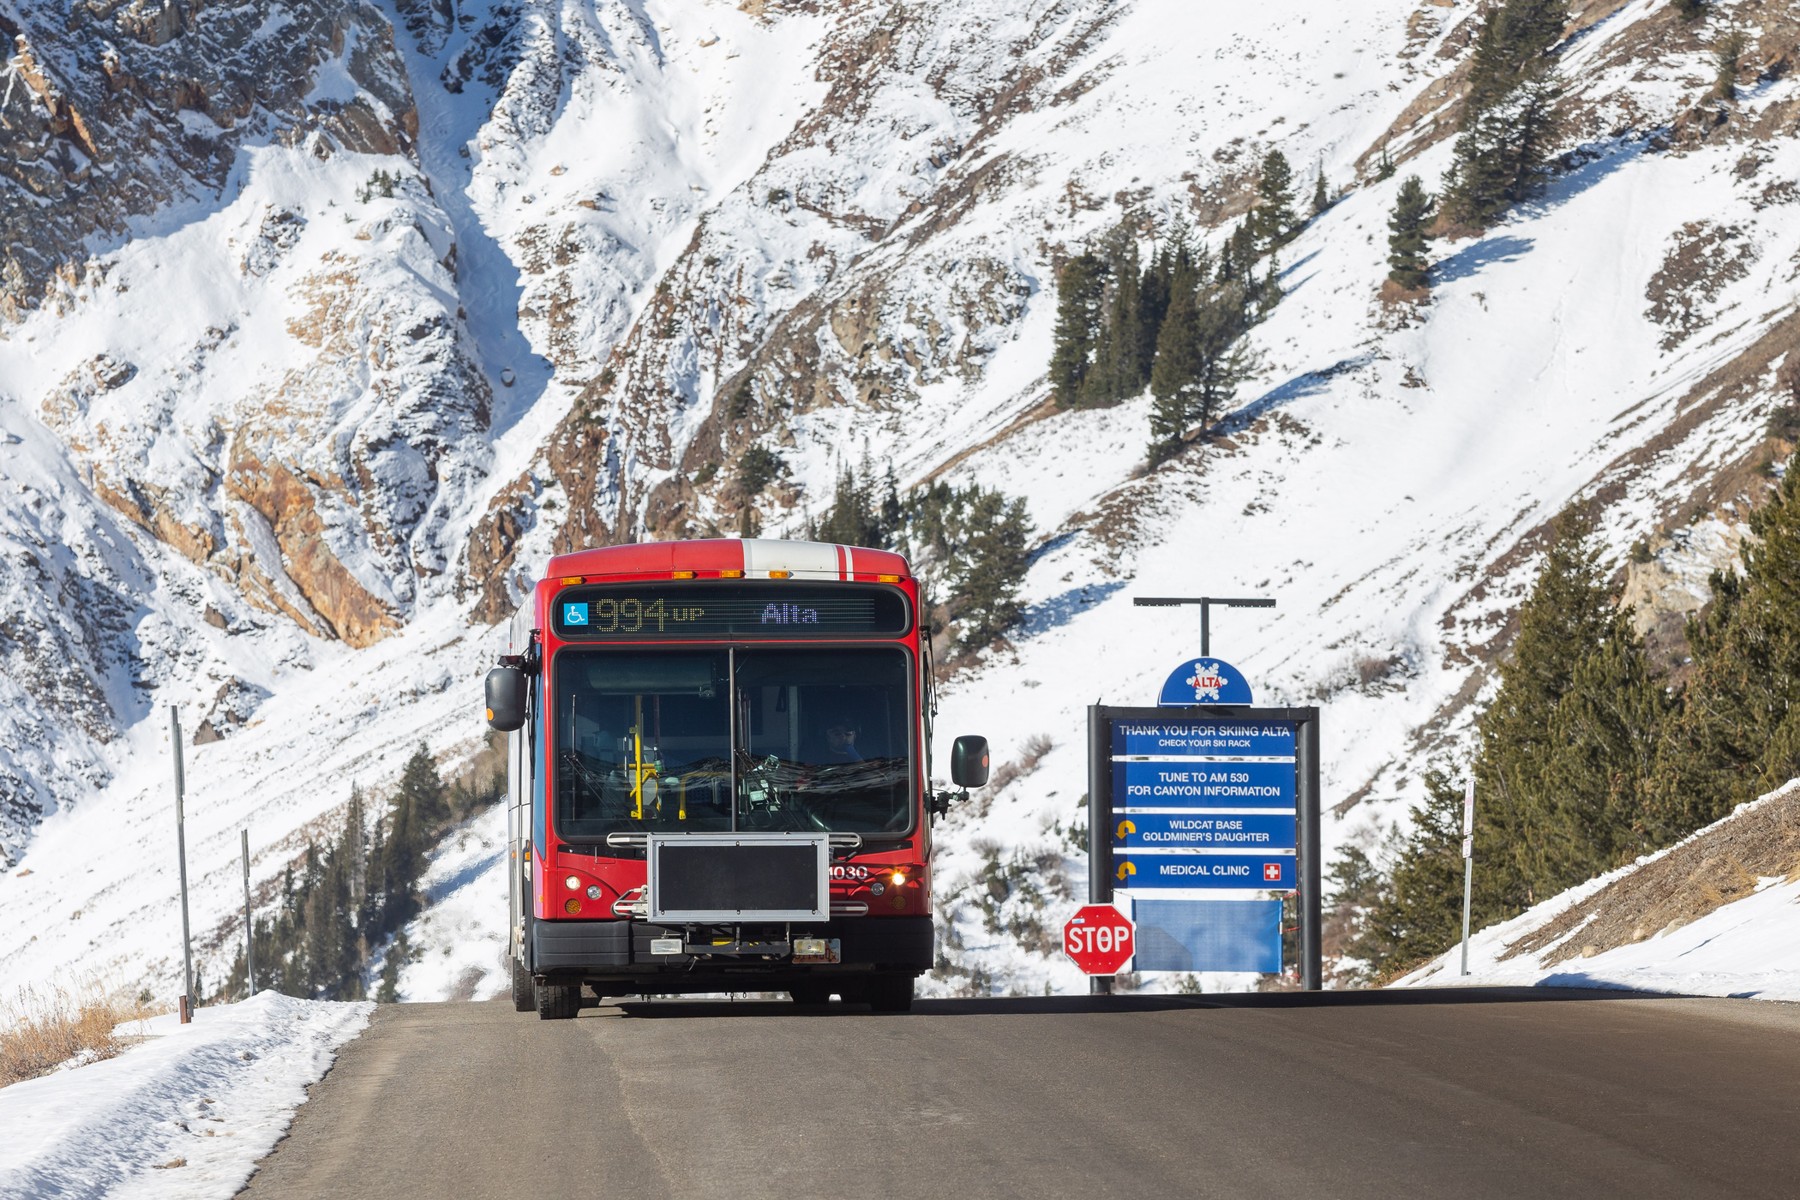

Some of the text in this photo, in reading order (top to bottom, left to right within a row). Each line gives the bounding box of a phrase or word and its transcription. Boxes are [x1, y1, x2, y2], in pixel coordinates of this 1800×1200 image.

[596, 598, 669, 632] 994
[761, 603, 820, 625] Alta
[1192, 676, 1223, 688] ALTA
[1119, 725, 1291, 738] THANK YOU FOR SKIING ALTA
[1158, 739, 1251, 748] CHECK YOUR SKI RACK
[1158, 772, 1250, 783] TUNE TO AM 530
[1127, 785, 1281, 797] FOR CANYON INFORMATION
[1169, 820, 1243, 830] WILDCAT BASE
[1142, 831, 1270, 842] GOLDMINER'S DAUGHTER
[1159, 865, 1250, 876] MEDICAL CLINIC
[1068, 926, 1130, 954] STOP
